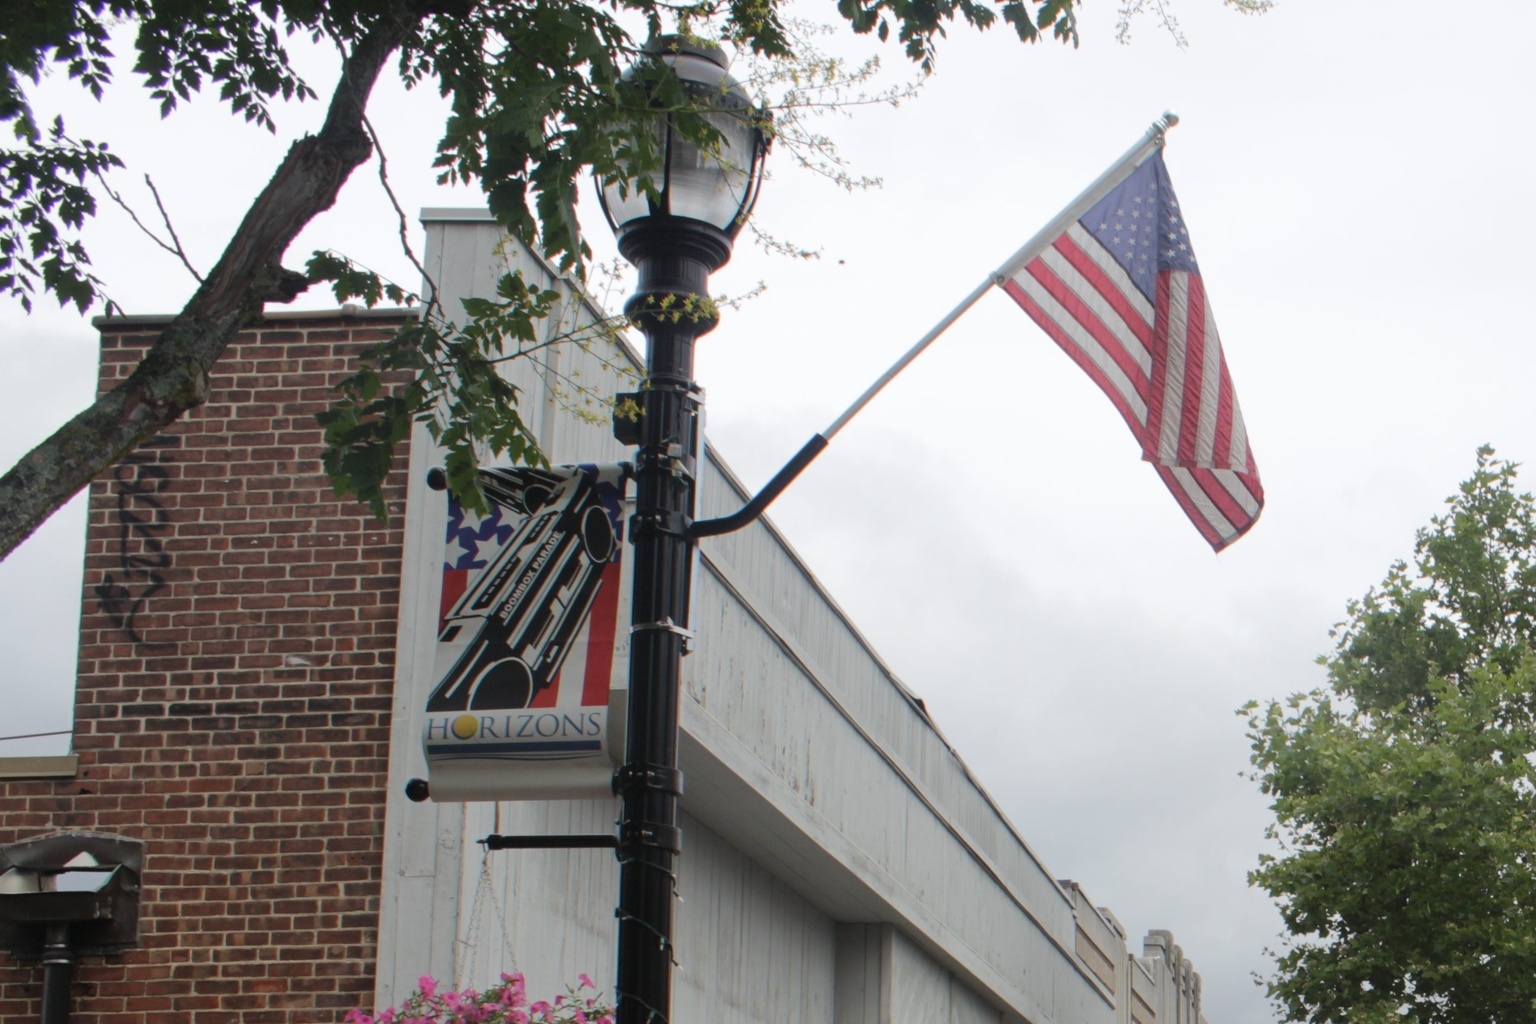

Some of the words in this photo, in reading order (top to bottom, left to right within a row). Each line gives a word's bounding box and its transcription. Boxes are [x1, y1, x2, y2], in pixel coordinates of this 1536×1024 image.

[499, 570, 535, 619] BOOMBOX
[532, 531, 562, 570] PARADE
[426, 712, 601, 741] HORIZONS
